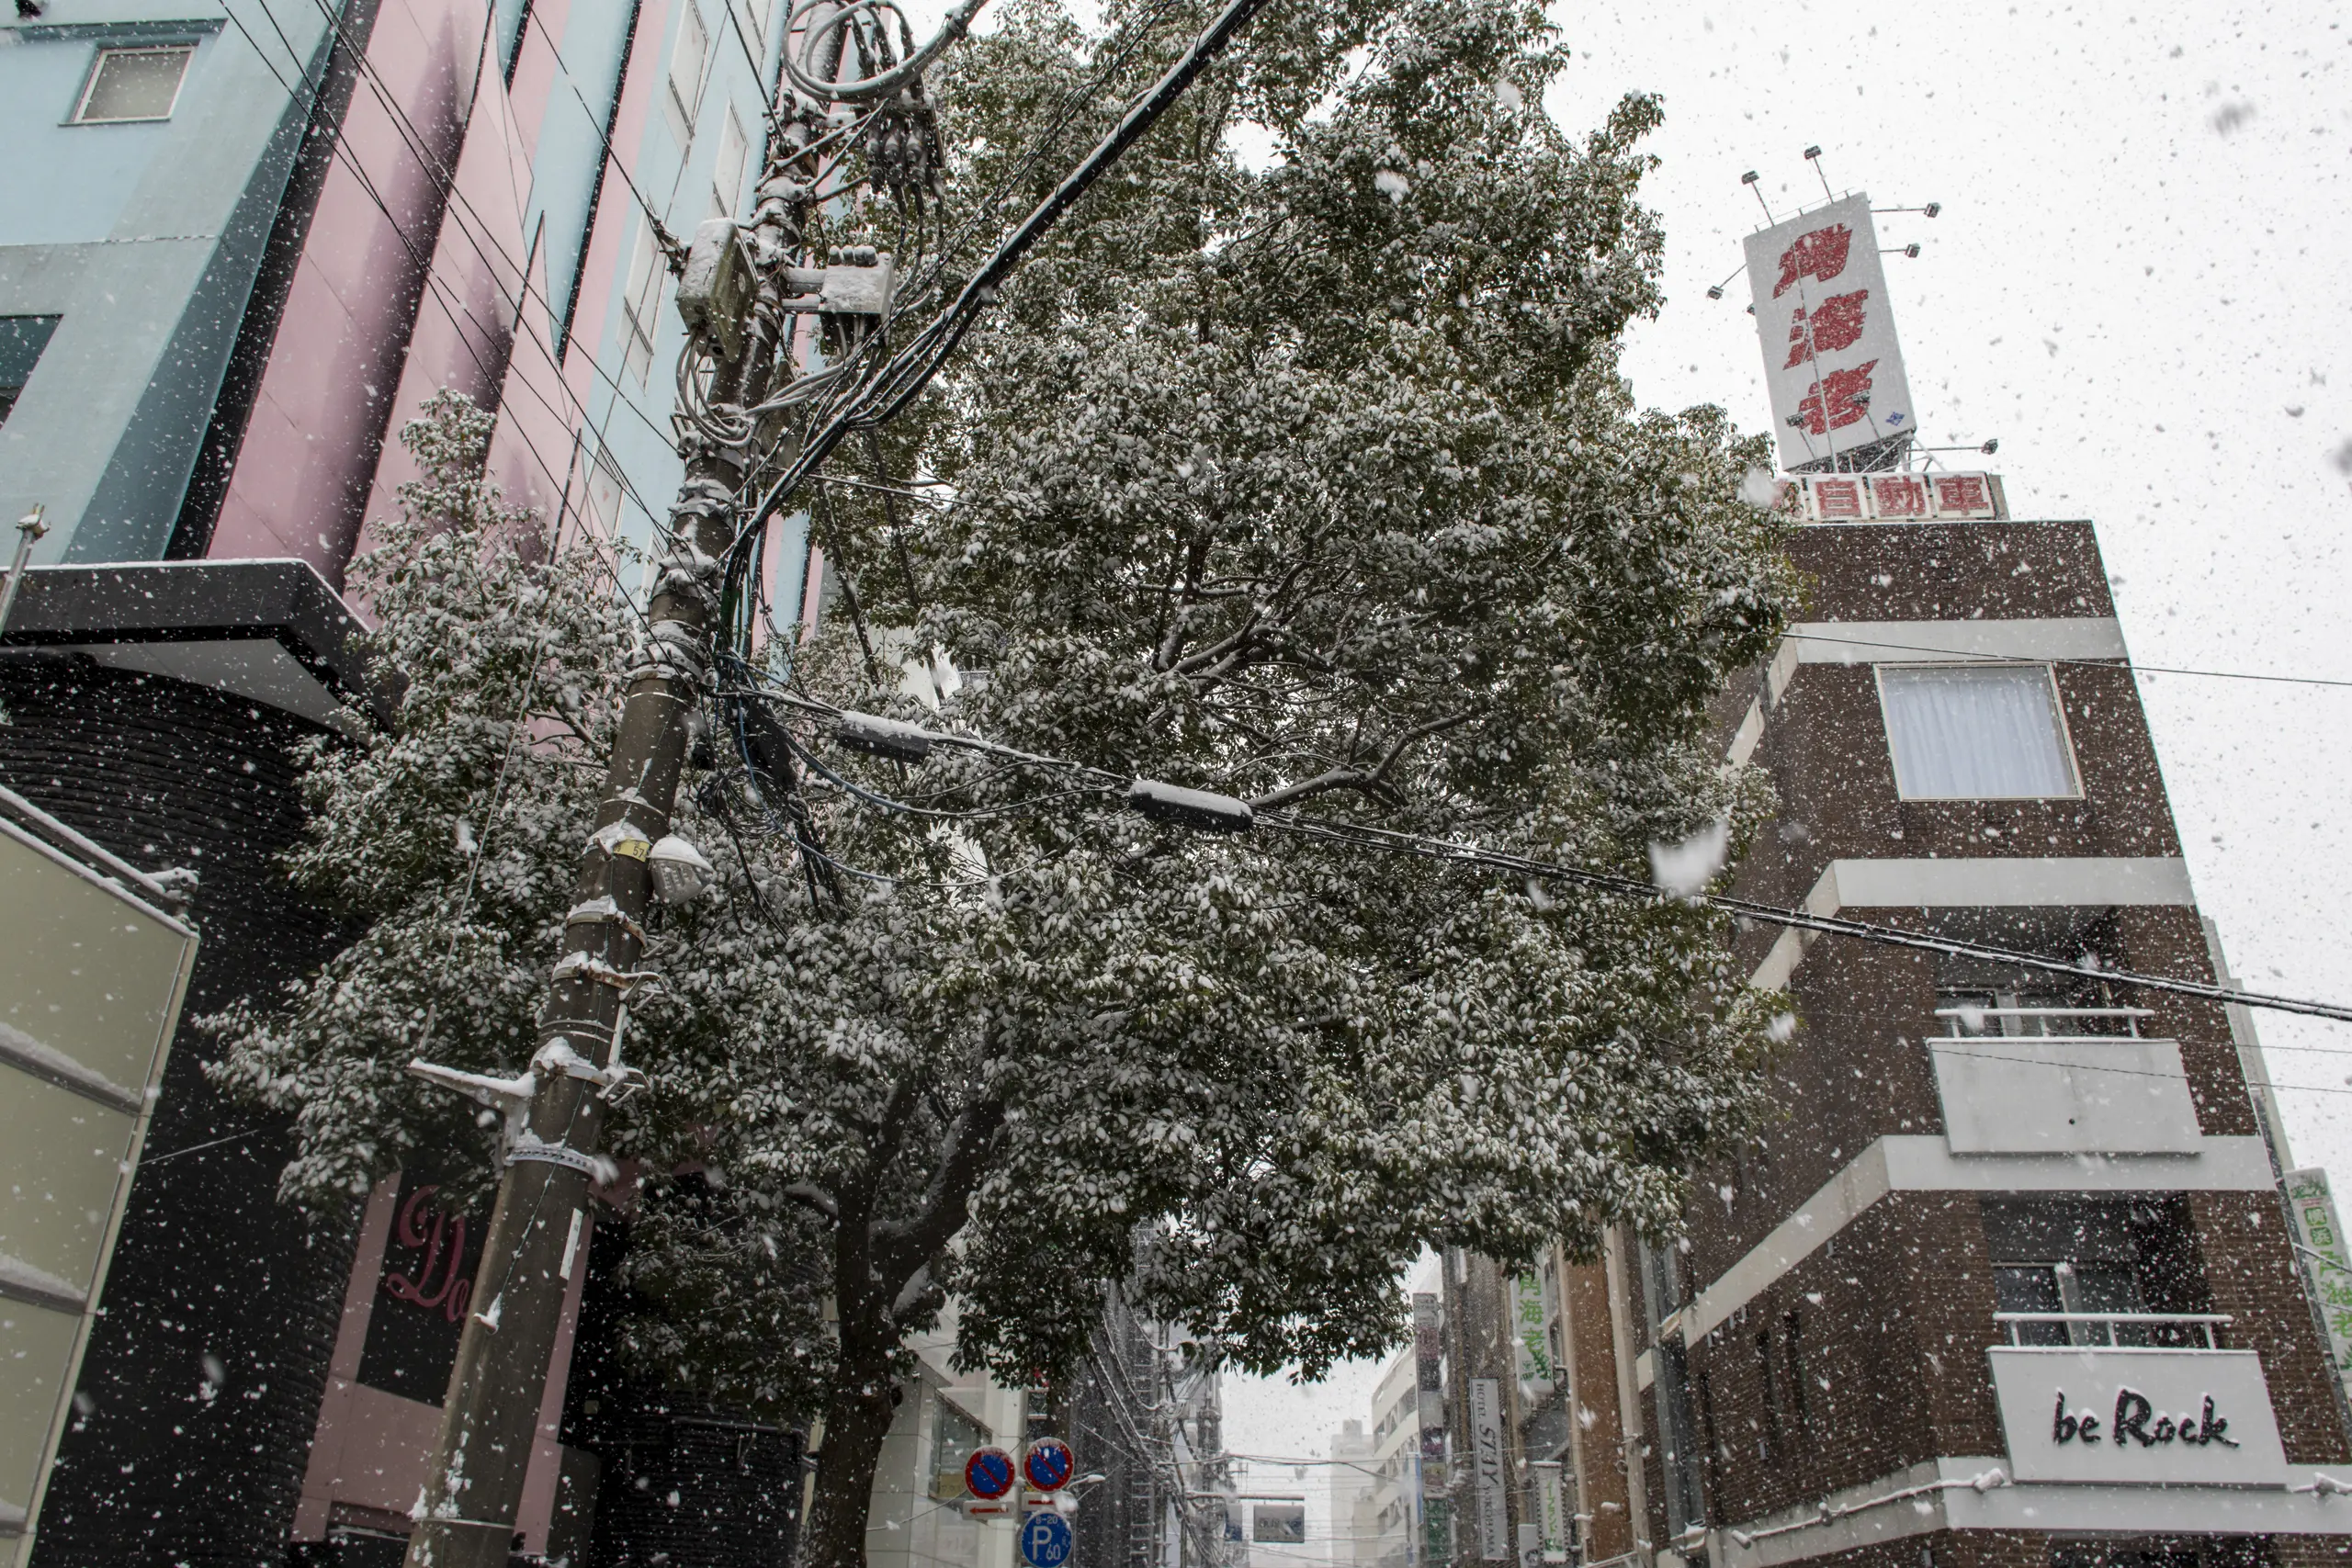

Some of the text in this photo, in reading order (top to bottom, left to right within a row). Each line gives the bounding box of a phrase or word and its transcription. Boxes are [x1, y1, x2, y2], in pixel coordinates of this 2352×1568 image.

[1476, 1383, 1487, 1419] HOTEL
[2053, 1387, 2240, 1449] be Rock
[1479, 1424, 1499, 1485] STAY
[1033, 1526, 1052, 1561] P
[1046, 1544, 1061, 1561] 60
